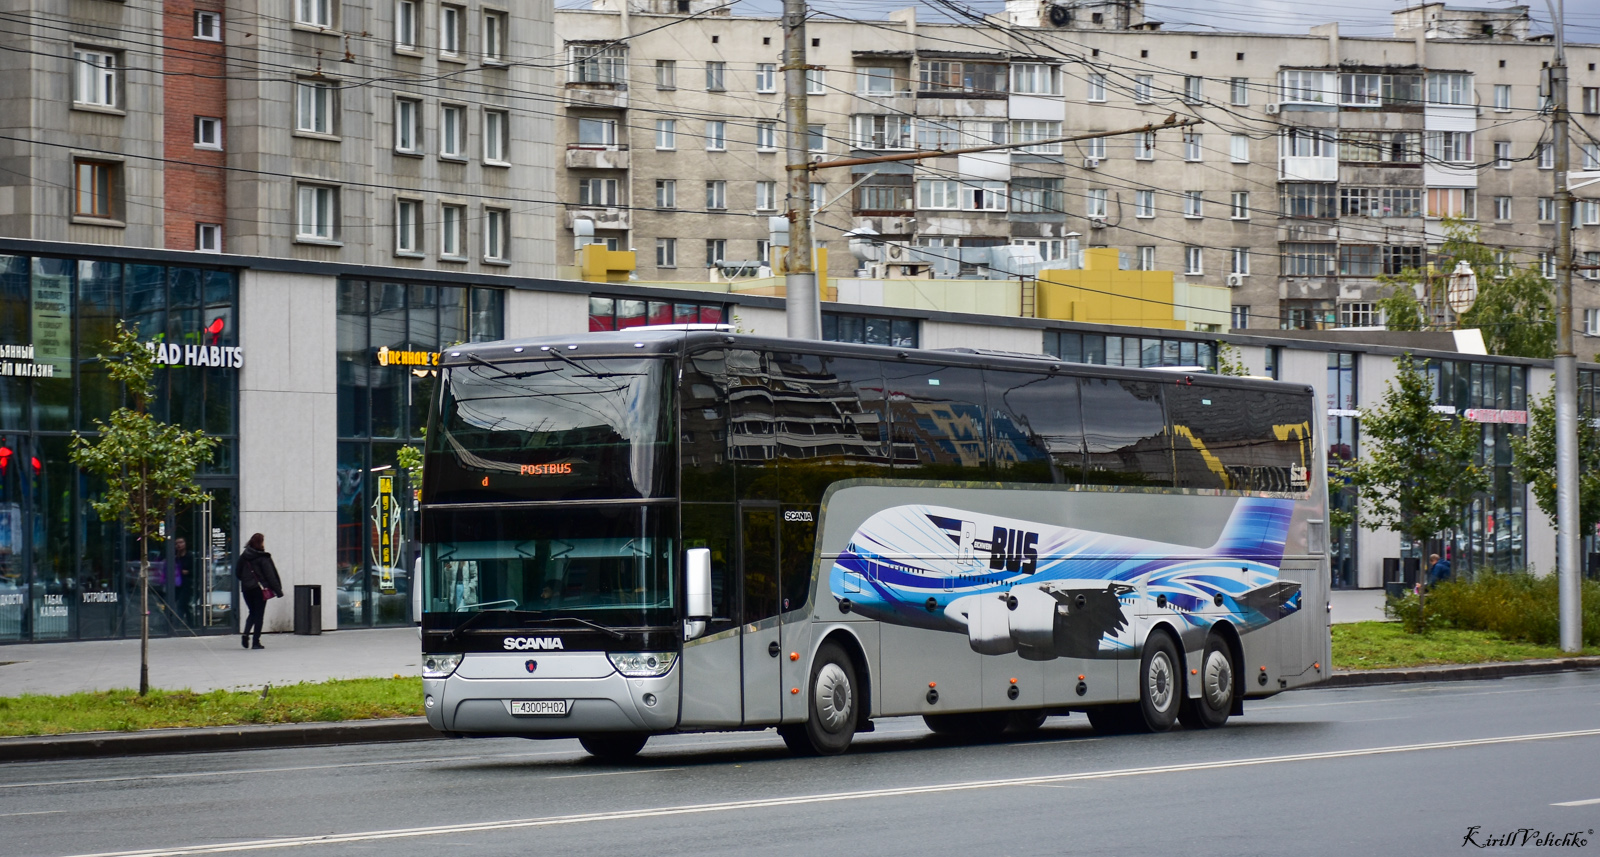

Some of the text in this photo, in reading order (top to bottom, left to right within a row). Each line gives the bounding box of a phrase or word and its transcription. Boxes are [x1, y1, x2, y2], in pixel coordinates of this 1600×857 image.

[184, 344, 244, 369] HABITS
[388, 350, 428, 366] пенная
[14, 363, 53, 377] МАГАЗИН
[520, 463, 572, 475] POSTBUS
[784, 511, 813, 521] SCANIA
[990, 526, 1038, 575] BUS
[44, 594, 64, 605] ТАБАК
[82, 590, 118, 603] УСТРОЙСТВА
[40, 606, 68, 617] КАЛЬЯНЫ
[503, 637, 564, 650] SCANIA
[521, 702, 564, 713] 4300PH02
